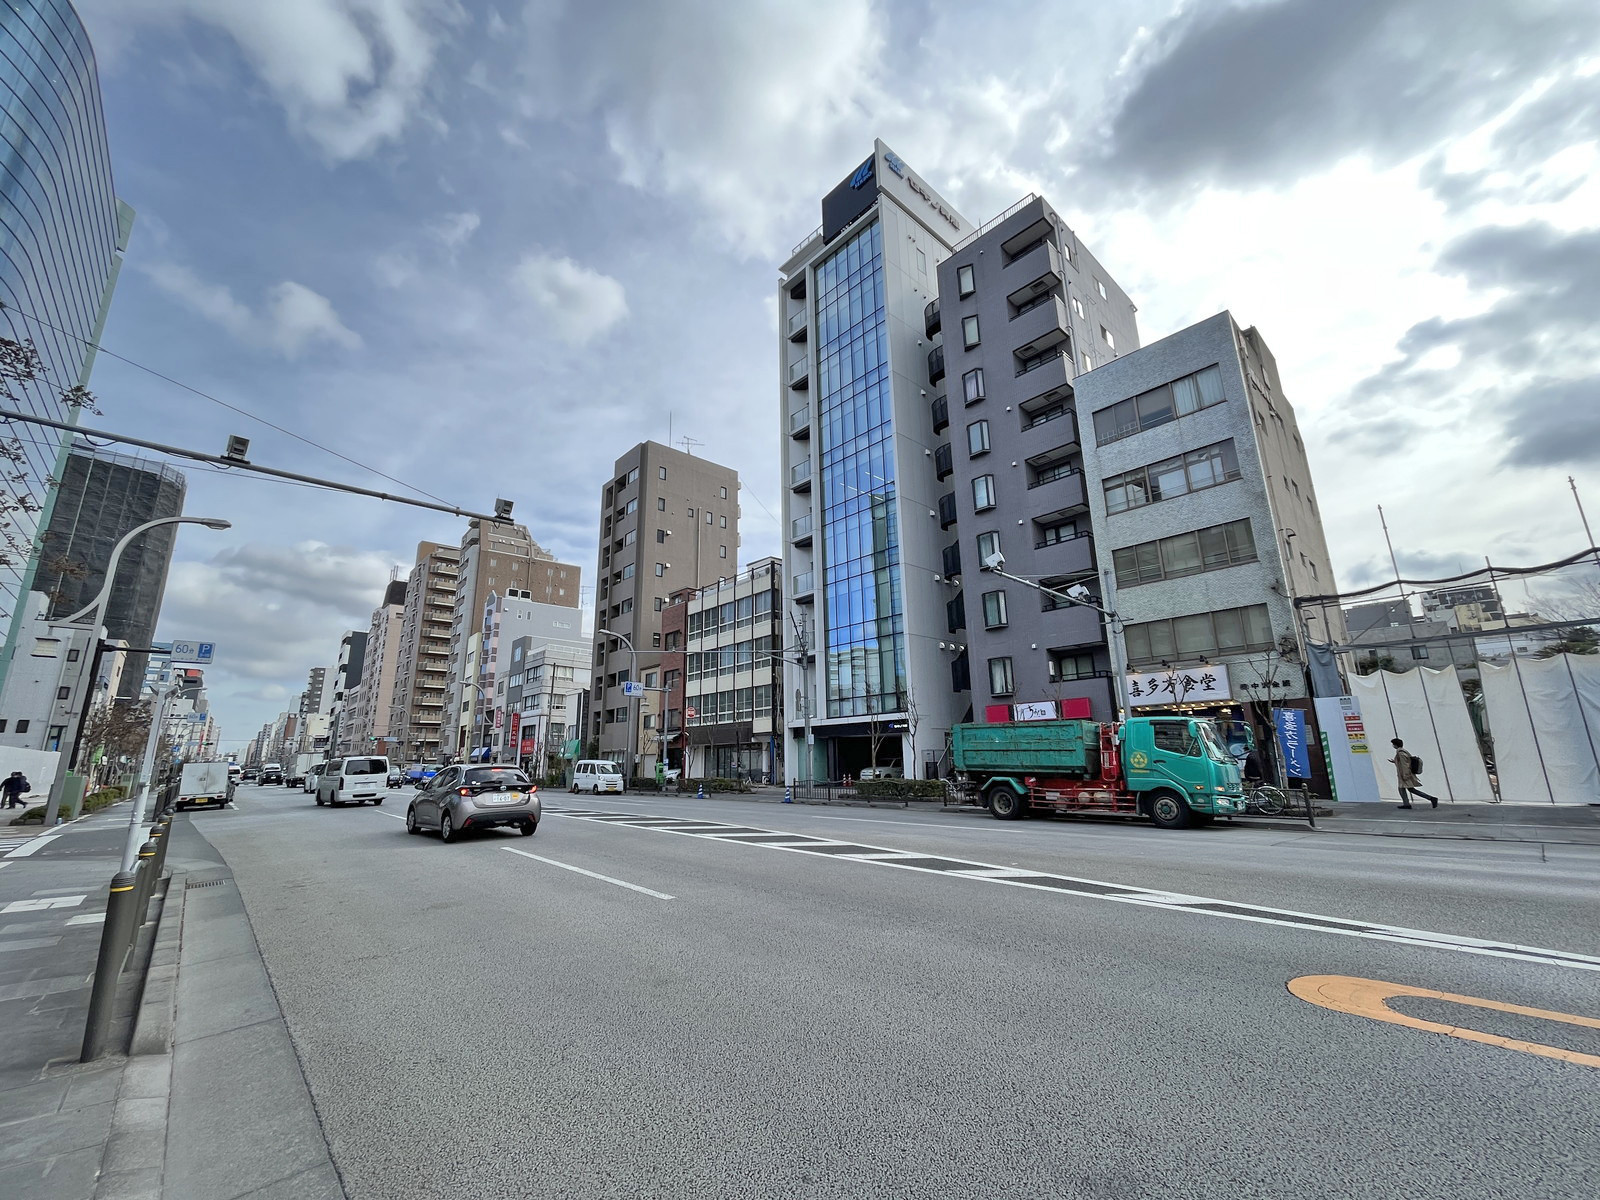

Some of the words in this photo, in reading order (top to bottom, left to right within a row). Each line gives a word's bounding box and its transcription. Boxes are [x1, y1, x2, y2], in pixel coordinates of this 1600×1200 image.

[1129, 673, 1217, 698] 喜多方食堂
